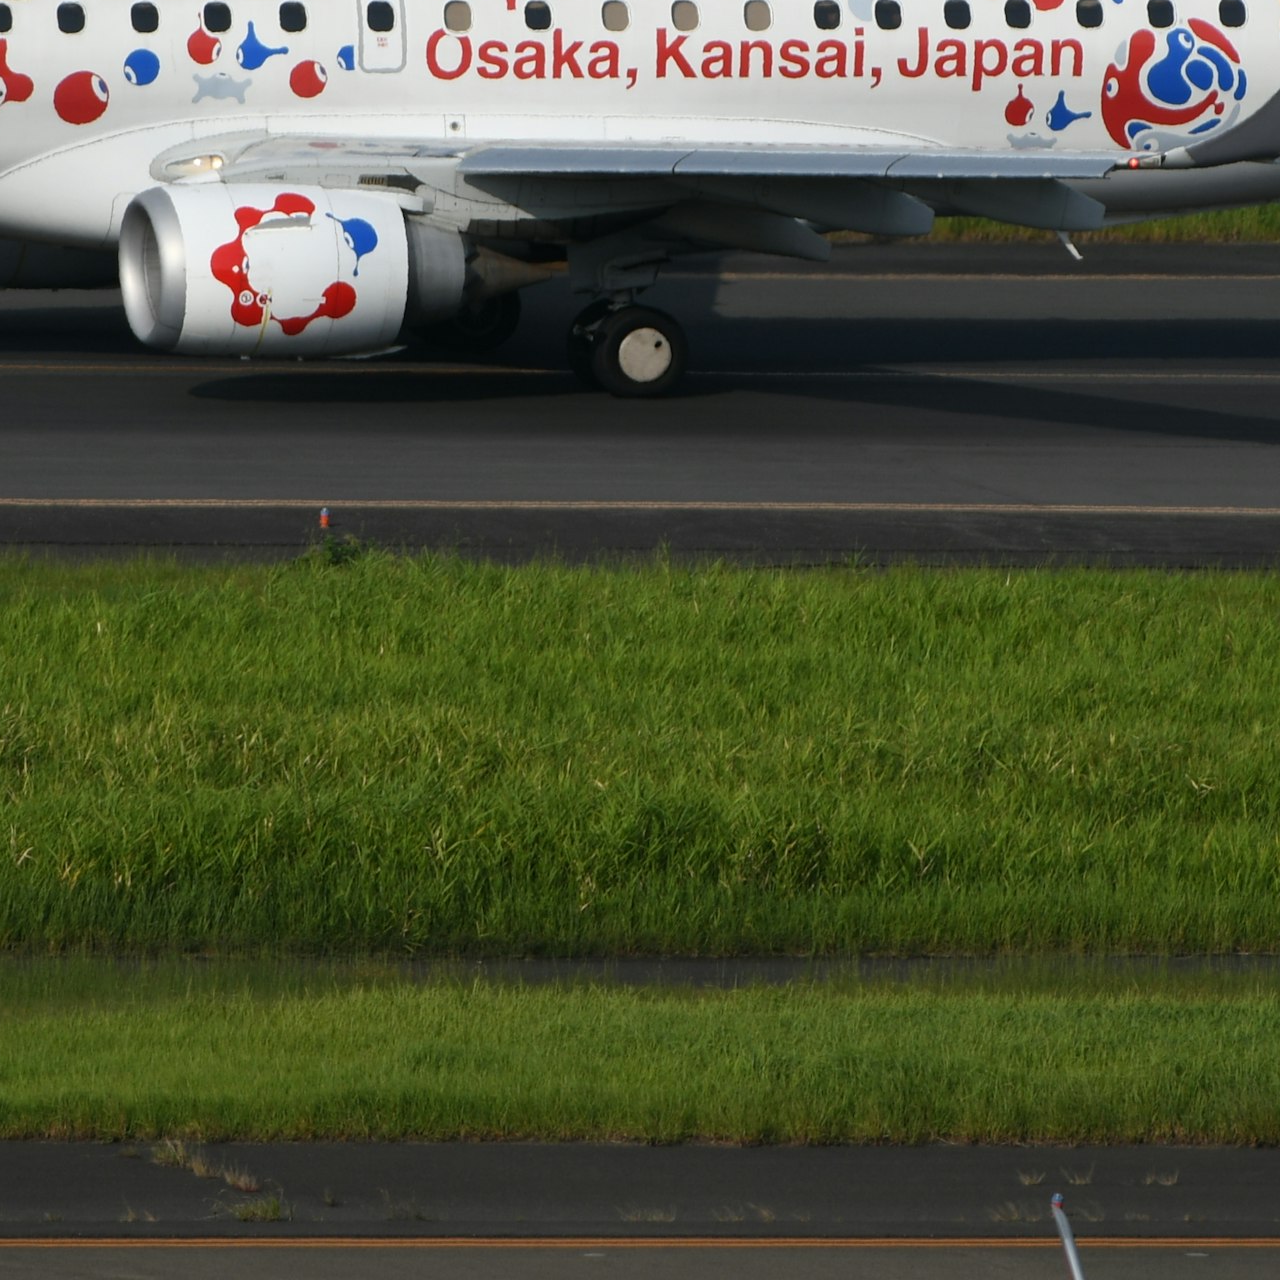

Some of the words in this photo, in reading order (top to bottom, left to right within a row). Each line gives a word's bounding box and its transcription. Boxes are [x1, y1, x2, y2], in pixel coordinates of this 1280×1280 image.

[425, 28, 640, 90] Osaka,
[655, 25, 883, 89] Kansai,
[897, 26, 1085, 92] Japan
